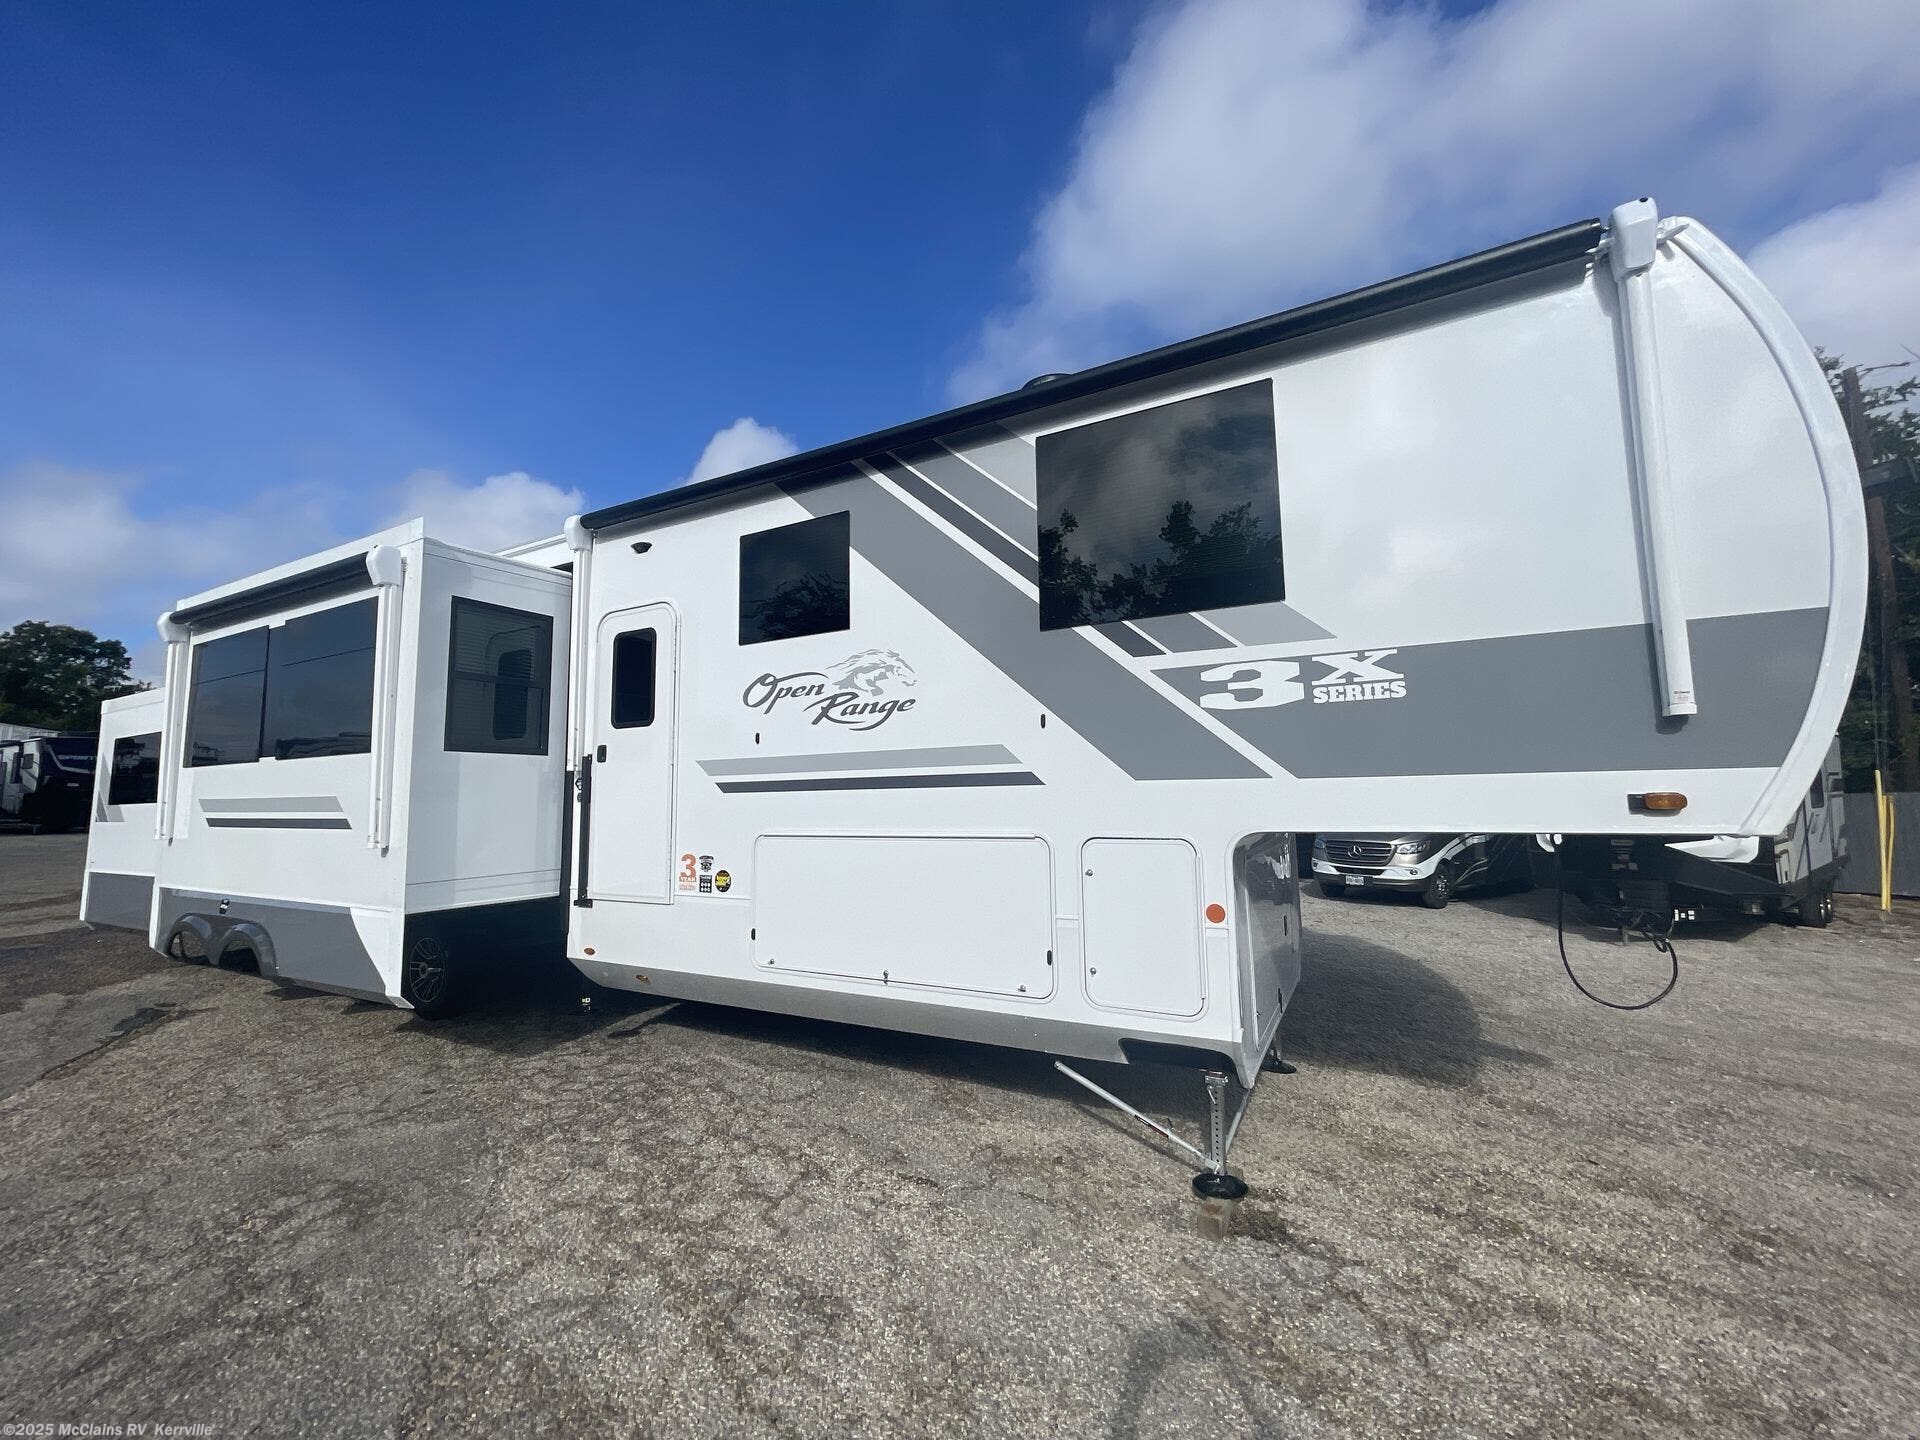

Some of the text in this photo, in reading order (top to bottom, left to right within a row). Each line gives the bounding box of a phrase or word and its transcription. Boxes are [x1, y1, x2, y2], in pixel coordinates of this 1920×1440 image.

[743, 672, 829, 714] Open
[1200, 660, 1304, 710] 3
[1312, 680, 1407, 704] SERIES
[803, 691, 916, 731] Range
[680, 853, 697, 877] 3
